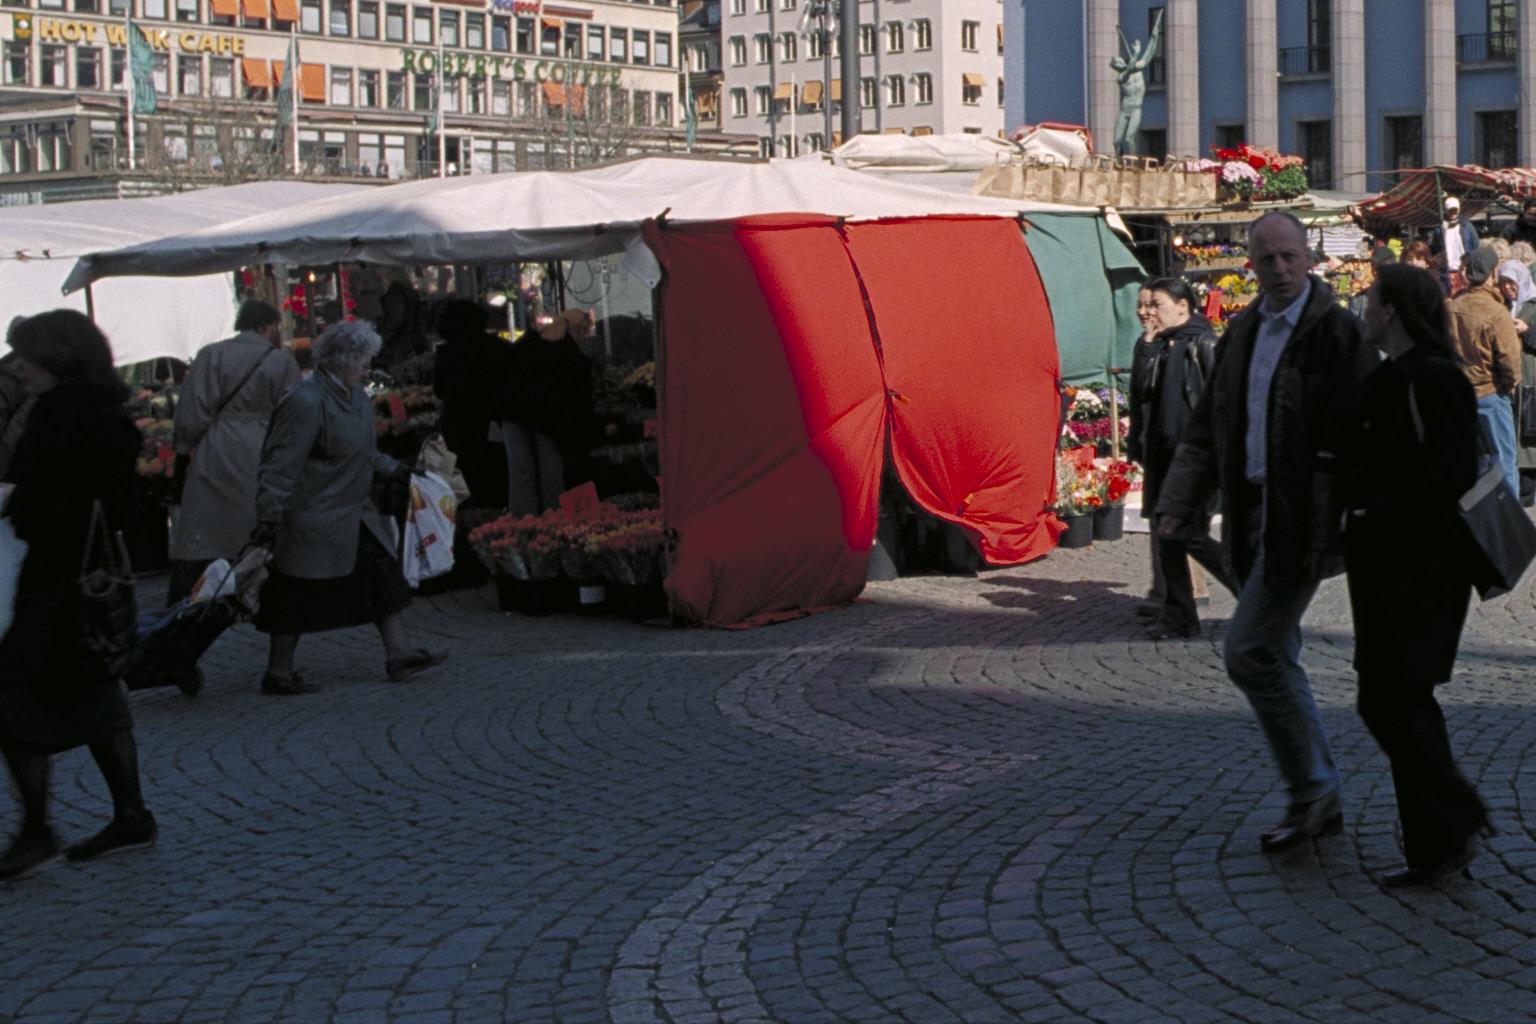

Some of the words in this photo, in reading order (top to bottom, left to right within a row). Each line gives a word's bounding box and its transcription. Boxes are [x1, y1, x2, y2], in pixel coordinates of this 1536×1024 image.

[40, 20, 97, 43] HOT
[178, 31, 246, 57] CAFE
[402, 48, 526, 79] ROBERT'S
[534, 58, 622, 88] COFFEE
